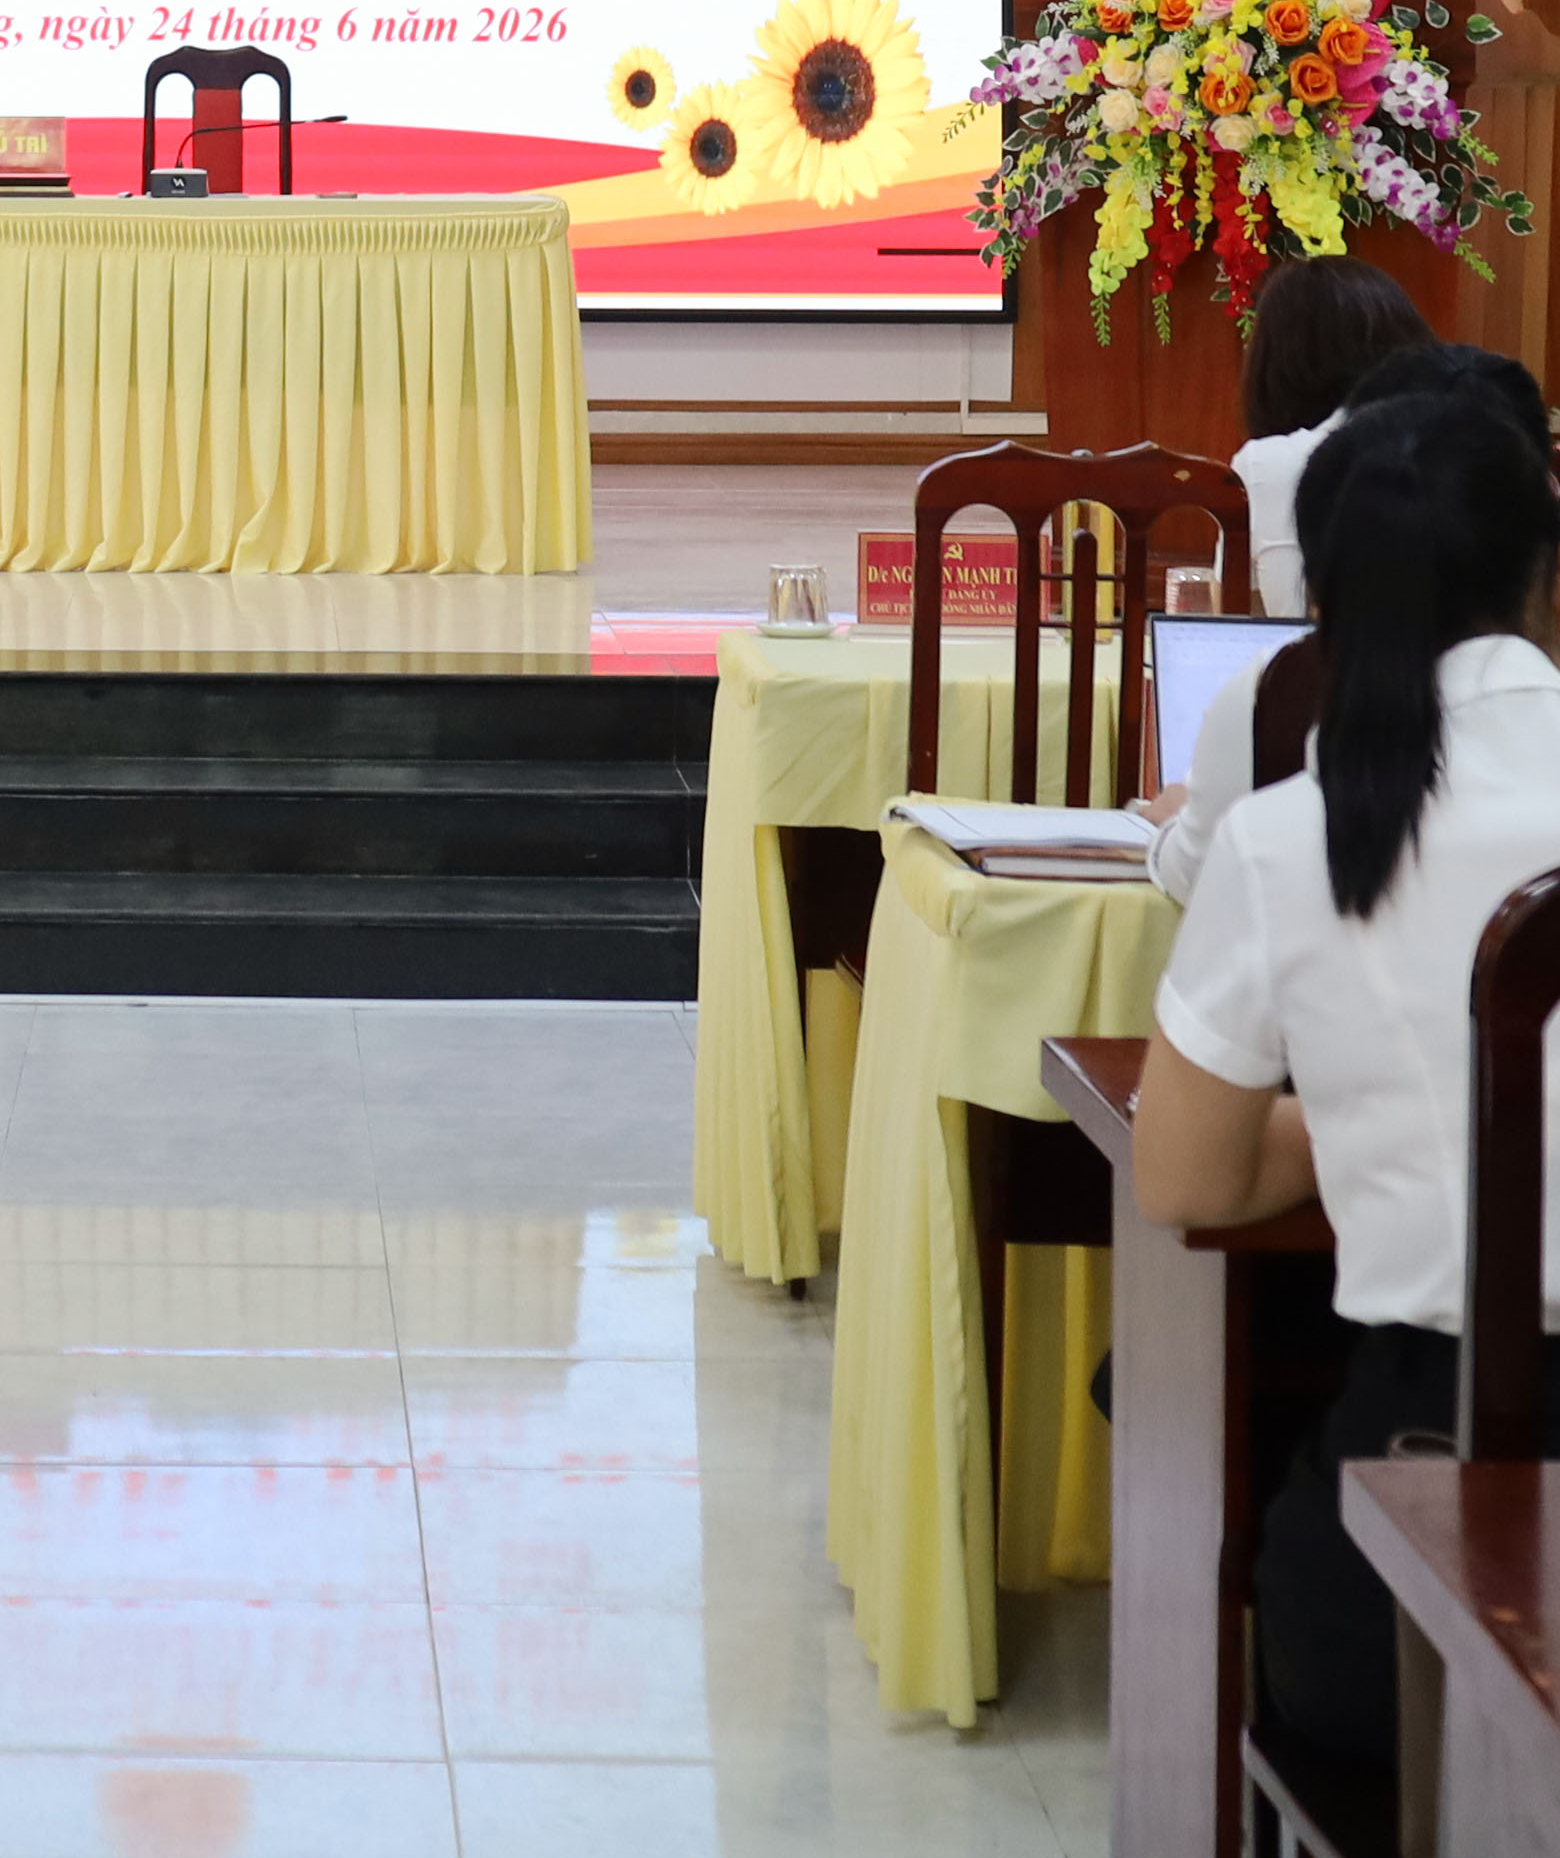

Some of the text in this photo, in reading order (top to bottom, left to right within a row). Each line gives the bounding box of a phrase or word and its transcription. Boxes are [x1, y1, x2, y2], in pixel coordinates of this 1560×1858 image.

[39, 5, 135, 51] ngày
[147, 5, 195, 41] 24
[207, 6, 321, 51] tháng
[337, 8, 358, 42] 6
[371, 9, 459, 43] năm
[473, 6, 567, 43] 2026
[15, 133, 47, 154] TRÌ
